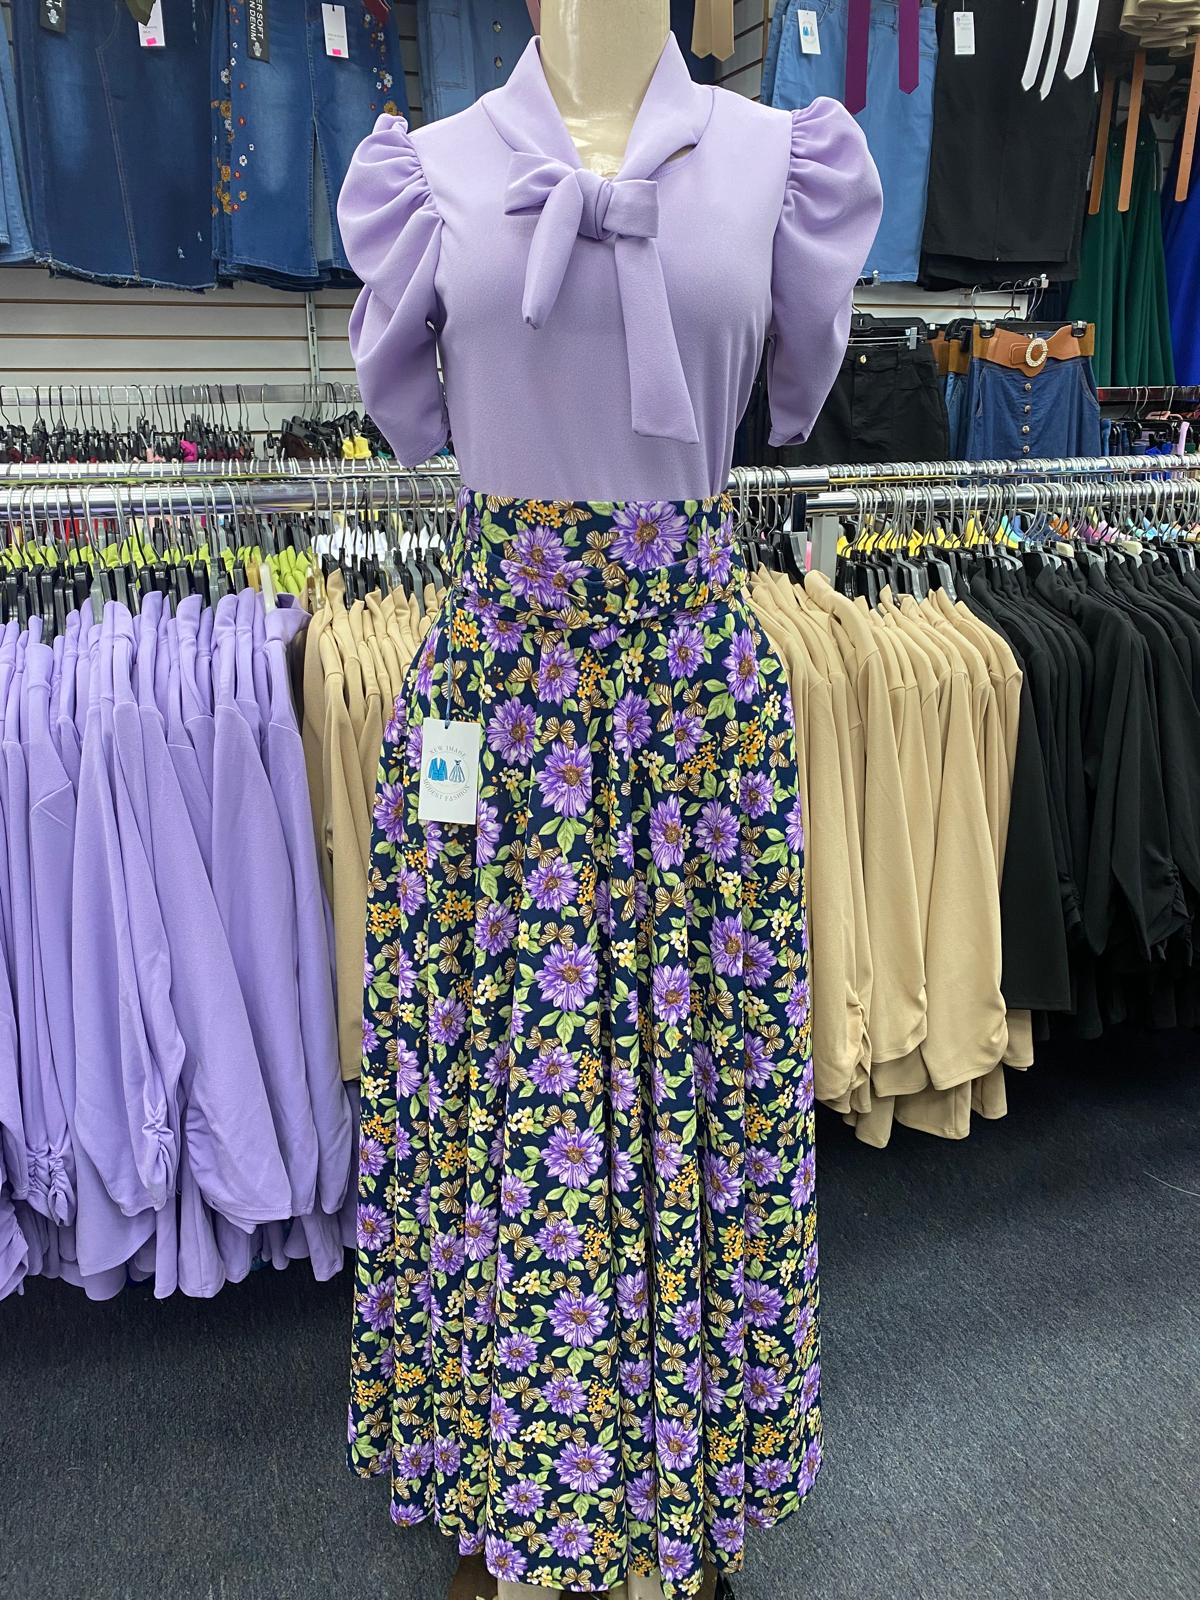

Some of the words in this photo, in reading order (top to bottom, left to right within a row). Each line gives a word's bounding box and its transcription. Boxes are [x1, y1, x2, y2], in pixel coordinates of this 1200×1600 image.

[446, 745, 466, 757] IMAGE
[423, 778, 443, 800] MODEST
[444, 784, 470, 802] FASHION
